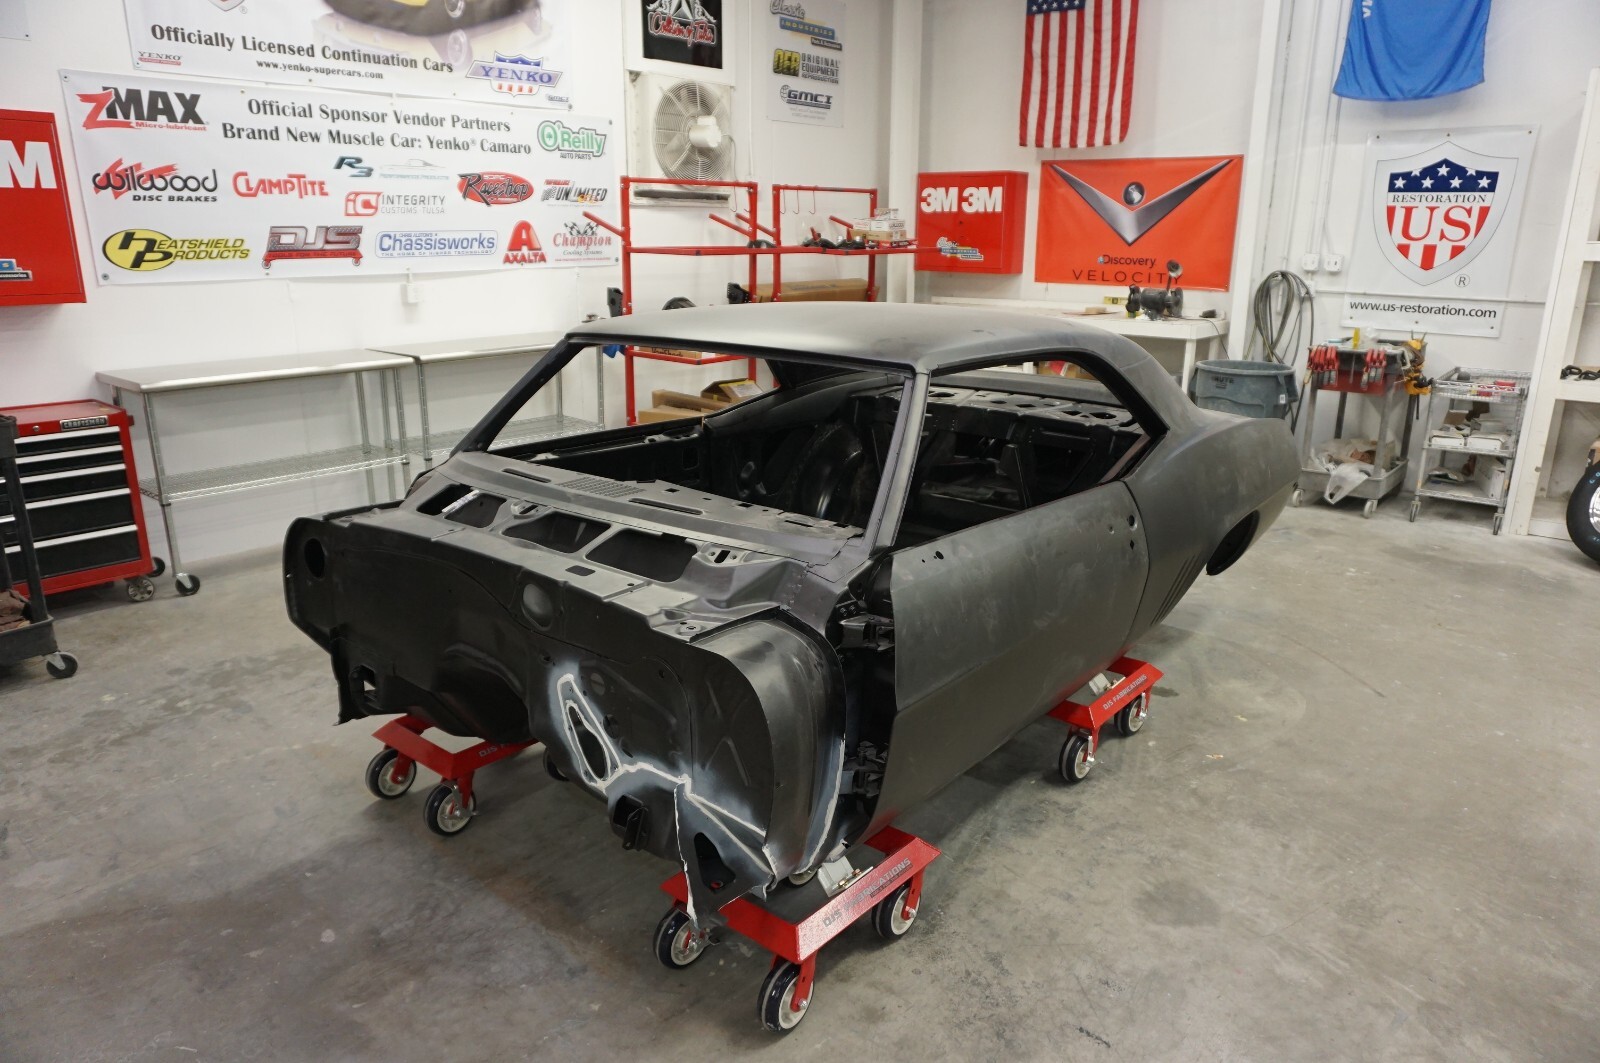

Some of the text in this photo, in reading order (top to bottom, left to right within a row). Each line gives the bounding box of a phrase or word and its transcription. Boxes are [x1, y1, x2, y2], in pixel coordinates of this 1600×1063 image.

[781, 19, 833, 35] INDUSTRIES
[138, 51, 182, 61] YENKO
[151, 24, 453, 73] Officially Licensed Continuation Cars
[802, 53, 839, 68] ORIGINAL
[257, 60, 384, 80] www.yenko-supercars.com
[480, 65, 552, 84] YENKO
[802, 63, 839, 77] EQUIPMENT
[787, 90, 833, 104] GMCI
[248, 99, 511, 132] Official Sponsor Vendor Partners
[135, 121, 207, 131] Micro-lubricant
[222, 122, 280, 141] Brand
[286, 126, 322, 143] New
[328, 129, 385, 146] Muscle
[390, 133, 422, 148] Car:
[480, 138, 531, 154] Camaro
[540, 121, 604, 154] O'Reilly
[457, 173, 528, 206] Raceshop
[555, 187, 608, 201] UNLIMITED
[1392, 193, 1487, 203] RESTORATION
[168, 195, 218, 203] BRAKES
[382, 194, 446, 206] INTEGRITY
[920, 186, 1003, 213] 3M 3M
[381, 206, 417, 214] CUSTOMS
[1400, 205, 1473, 243] US
[267, 225, 363, 251] DJS
[379, 233, 495, 252] Chassisworks
[553, 232, 612, 250] Champion
[503, 252, 547, 264] AXALTA
[1102, 254, 1157, 268] Discovery
[1349, 301, 1497, 319] www.us-restoration.com
[64, 418, 105, 428] CRAFTSMAN
[1102, 699, 1114, 710] DJS
[1113, 674, 1147, 702] FABRICATIONS
[822, 908, 842, 927] DJS
